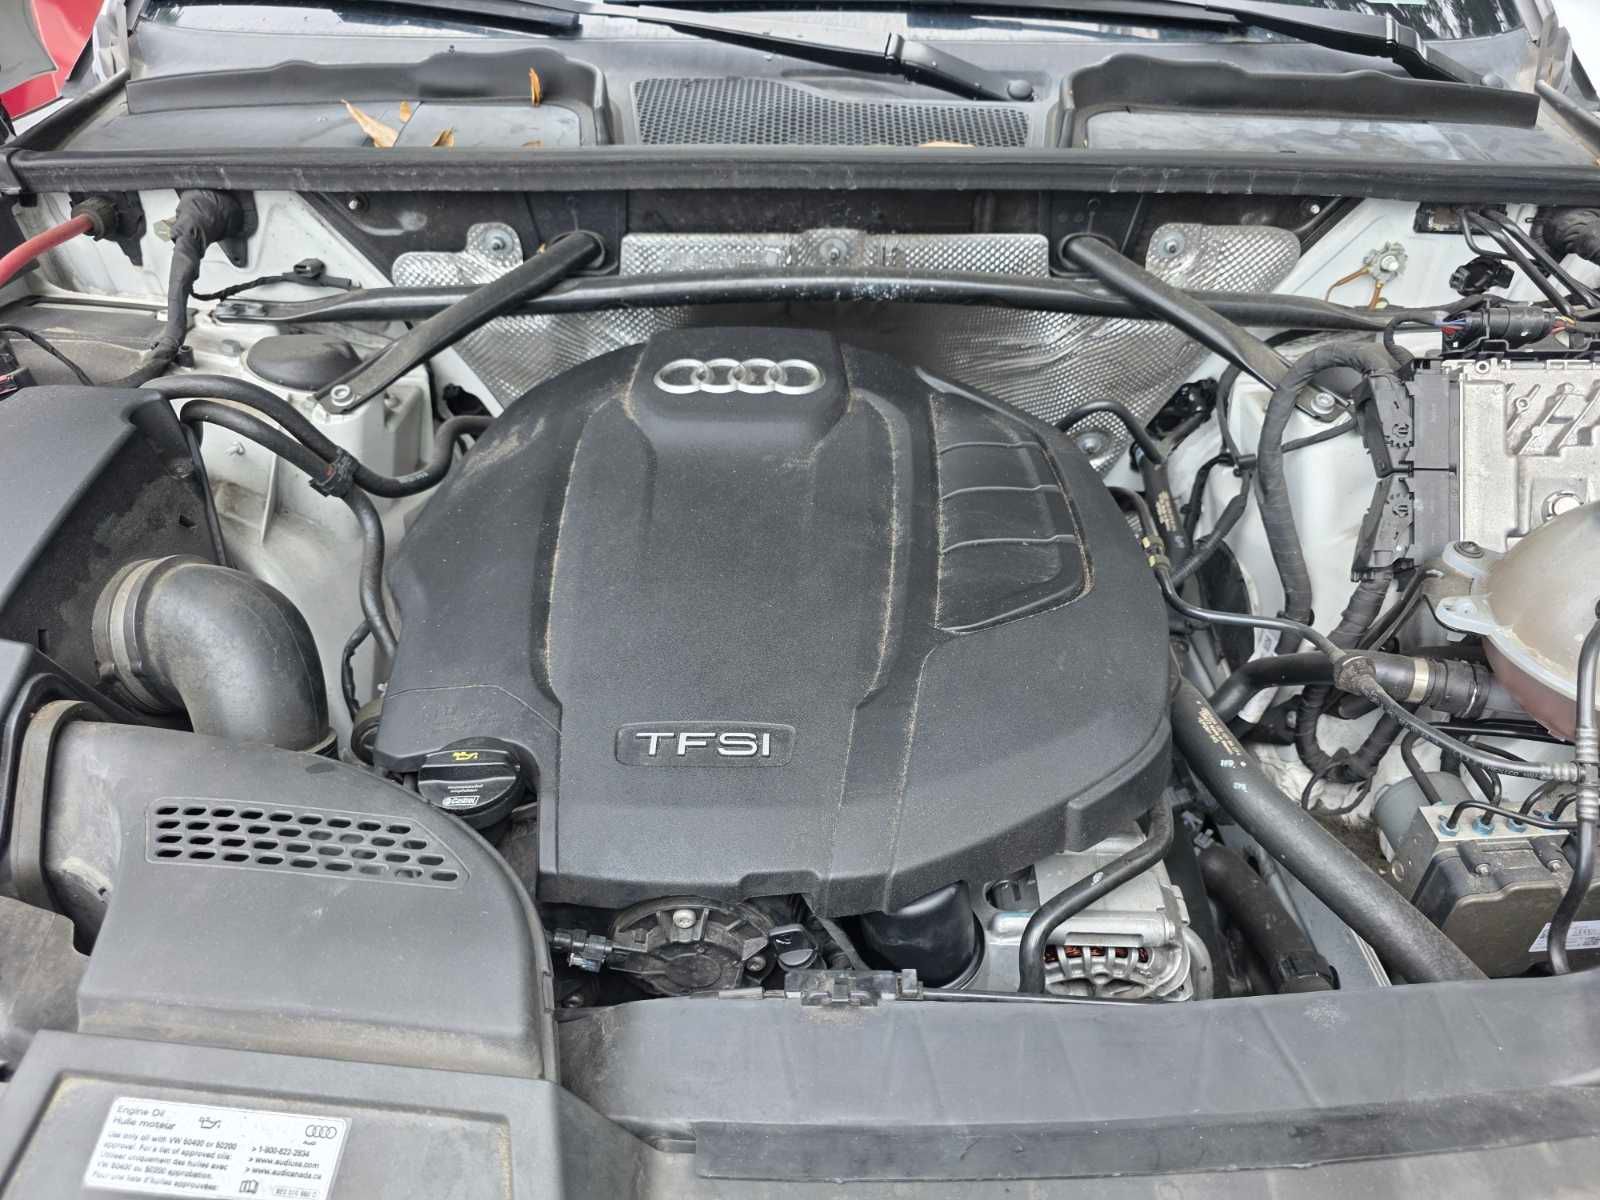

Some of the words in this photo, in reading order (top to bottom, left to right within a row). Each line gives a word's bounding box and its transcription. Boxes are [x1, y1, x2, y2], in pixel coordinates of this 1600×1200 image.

[636, 732, 770, 757] TFSI
[117, 1105, 149, 1116] Engine
[152, 1108, 166, 1117] Oil
[113, 1117, 136, 1126] Huile
[139, 1120, 176, 1130] moteur
[169, 1136, 181, 1145] VW
[255, 1158, 320, 1168] www.audiusa.com
[251, 1168, 322, 1180] www.audicanada.ca
